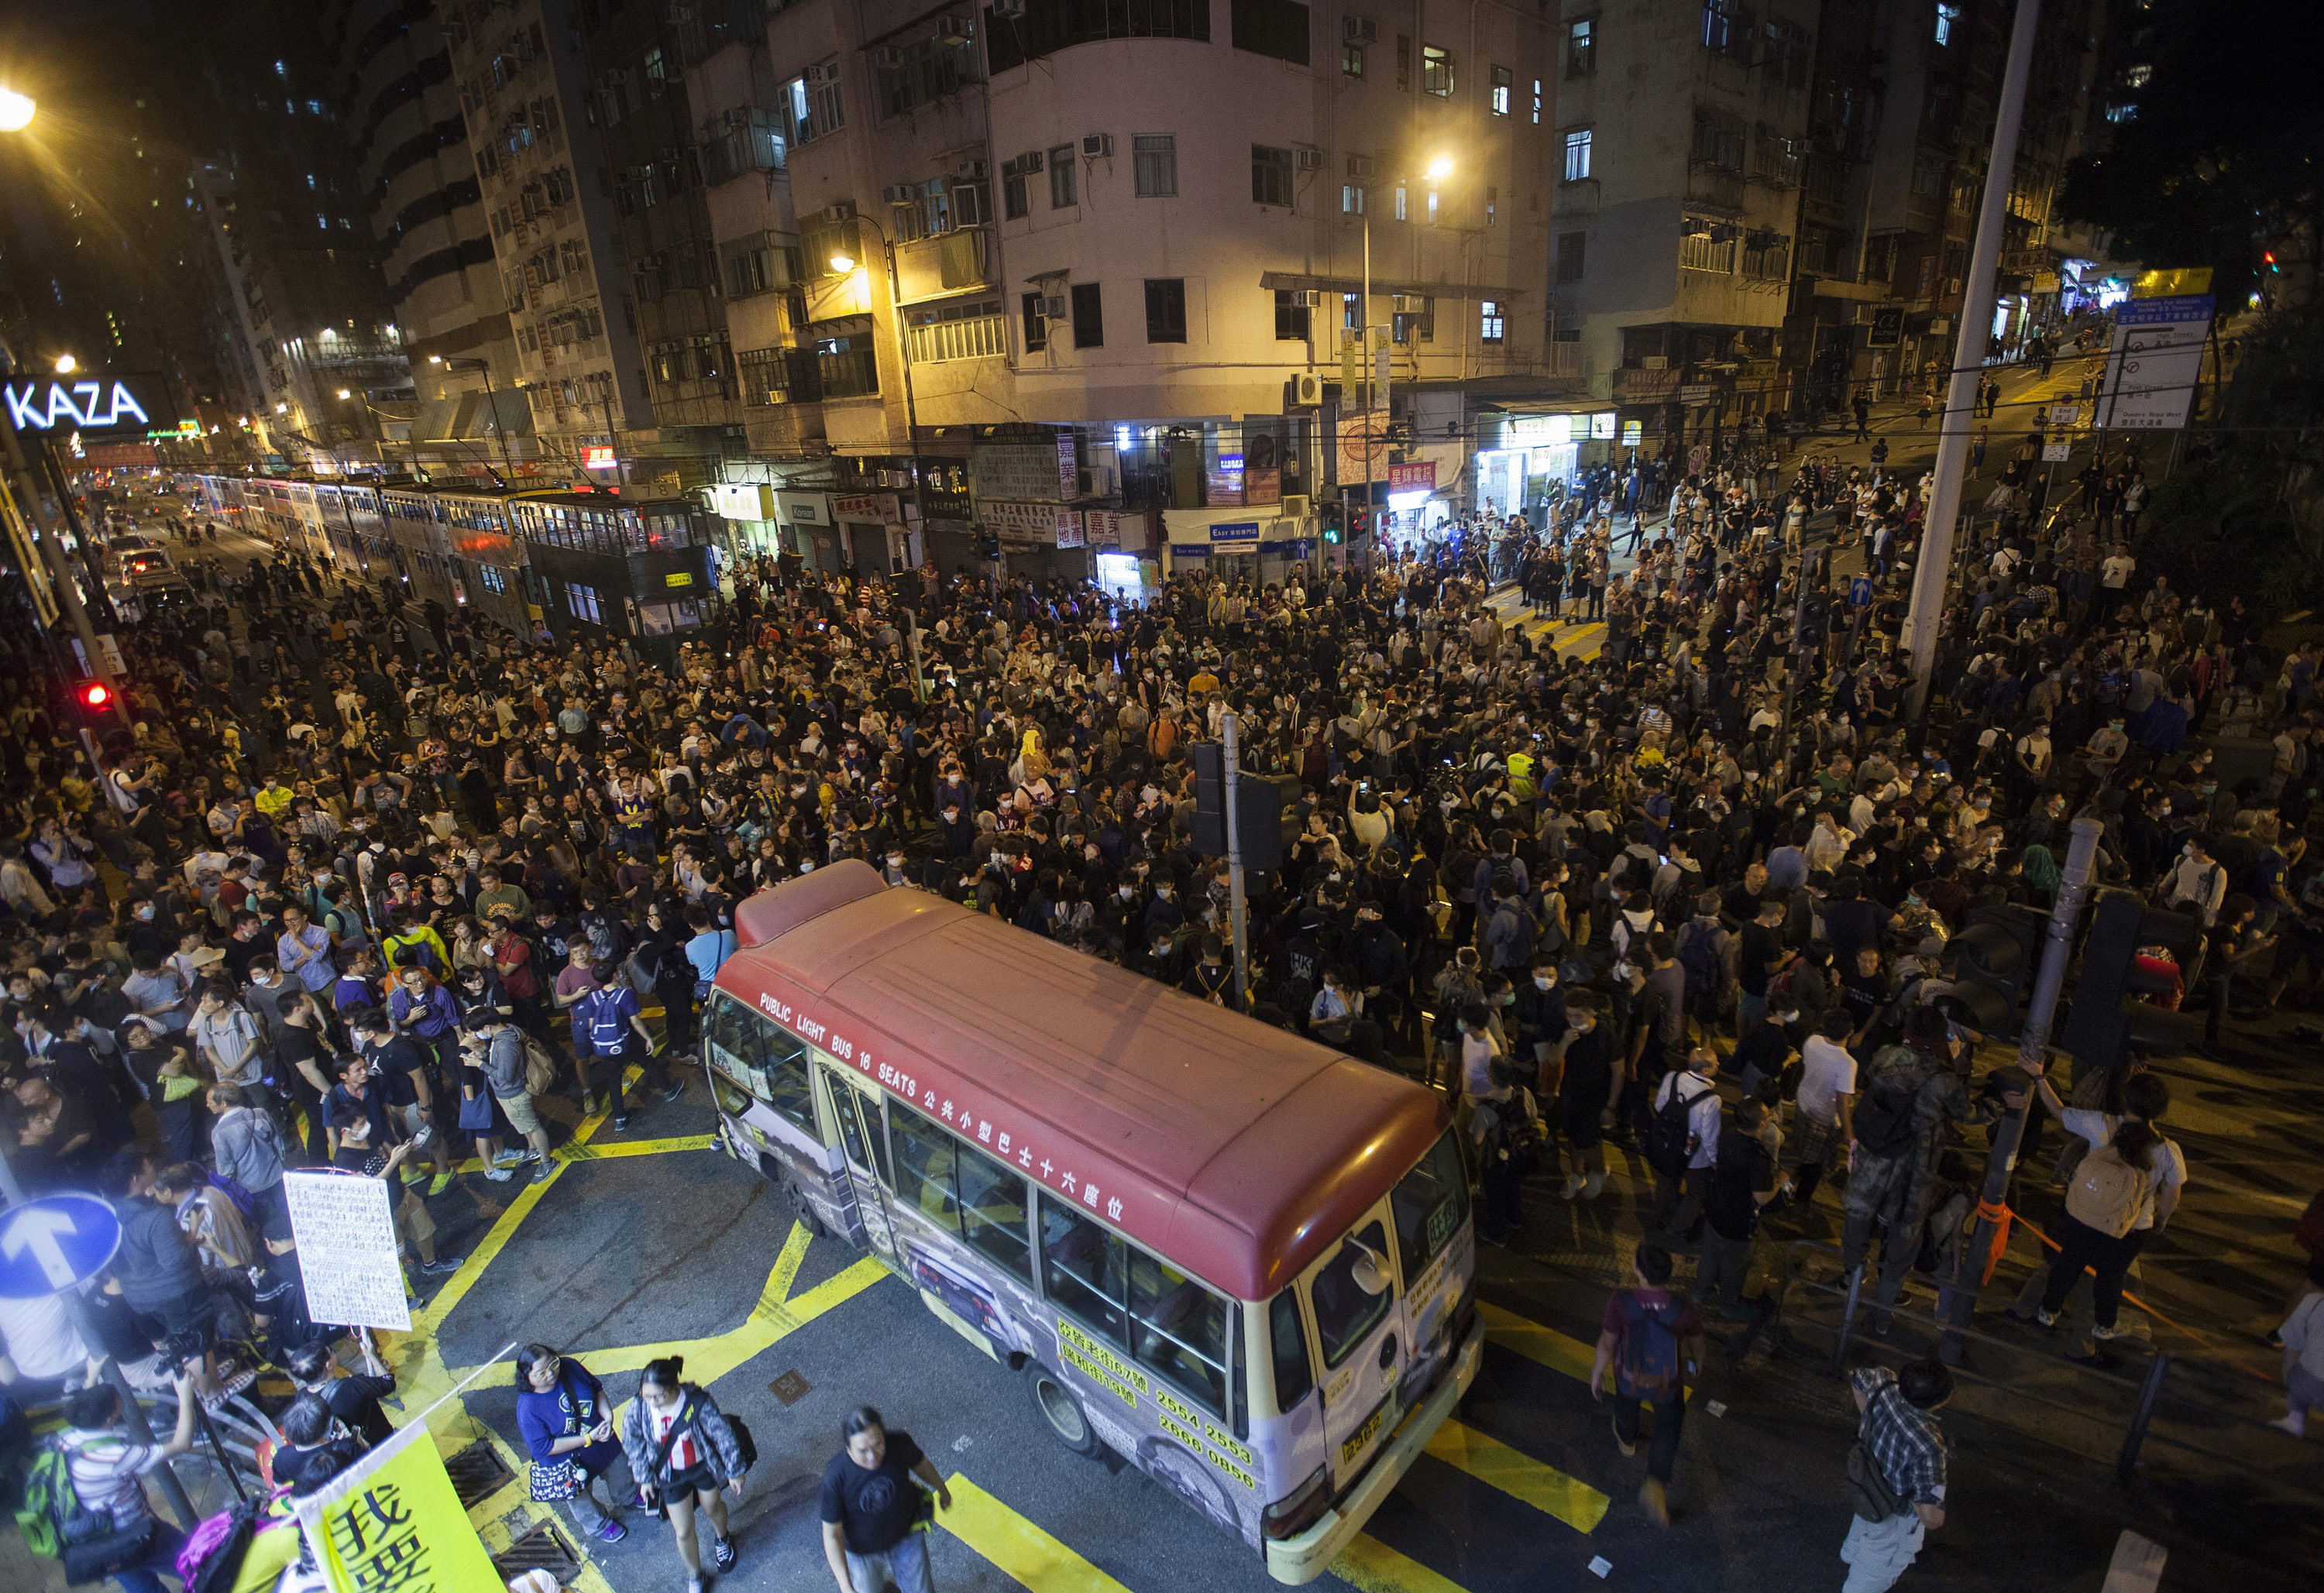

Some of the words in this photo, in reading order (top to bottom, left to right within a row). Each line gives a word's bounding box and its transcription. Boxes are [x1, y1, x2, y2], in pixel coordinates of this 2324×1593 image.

[3, 380, 149, 431] KAZA
[1391, 465, 1432, 486] 星輝電訊
[642, 485, 669, 496] 78
[793, 507, 813, 518] Korean
[1057, 512, 1081, 528] 嘉業
[1057, 527, 1083, 543] 地產
[1212, 528, 1229, 537] EASY
[760, 992, 792, 1023] PUBLIC
[796, 1014, 826, 1042] LIGHT
[831, 1035, 852, 1059] BUS
[859, 1051, 871, 1070] 16
[878, 1062, 917, 1097] SEATS
[924, 1090, 1123, 1222] 公共小型巴士十六座位
[1058, 1319, 1148, 1394] 亞皆老街67號
[1157, 1391, 1200, 1430] 2554
[1205, 1424, 1252, 1465] 2553
[1062, 1344, 1136, 1408] 瑞和街19號
[1160, 1416, 1202, 1454] 2666
[1208, 1450, 1254, 1489] 0856
[331, 1484, 435, 1593] 我要
